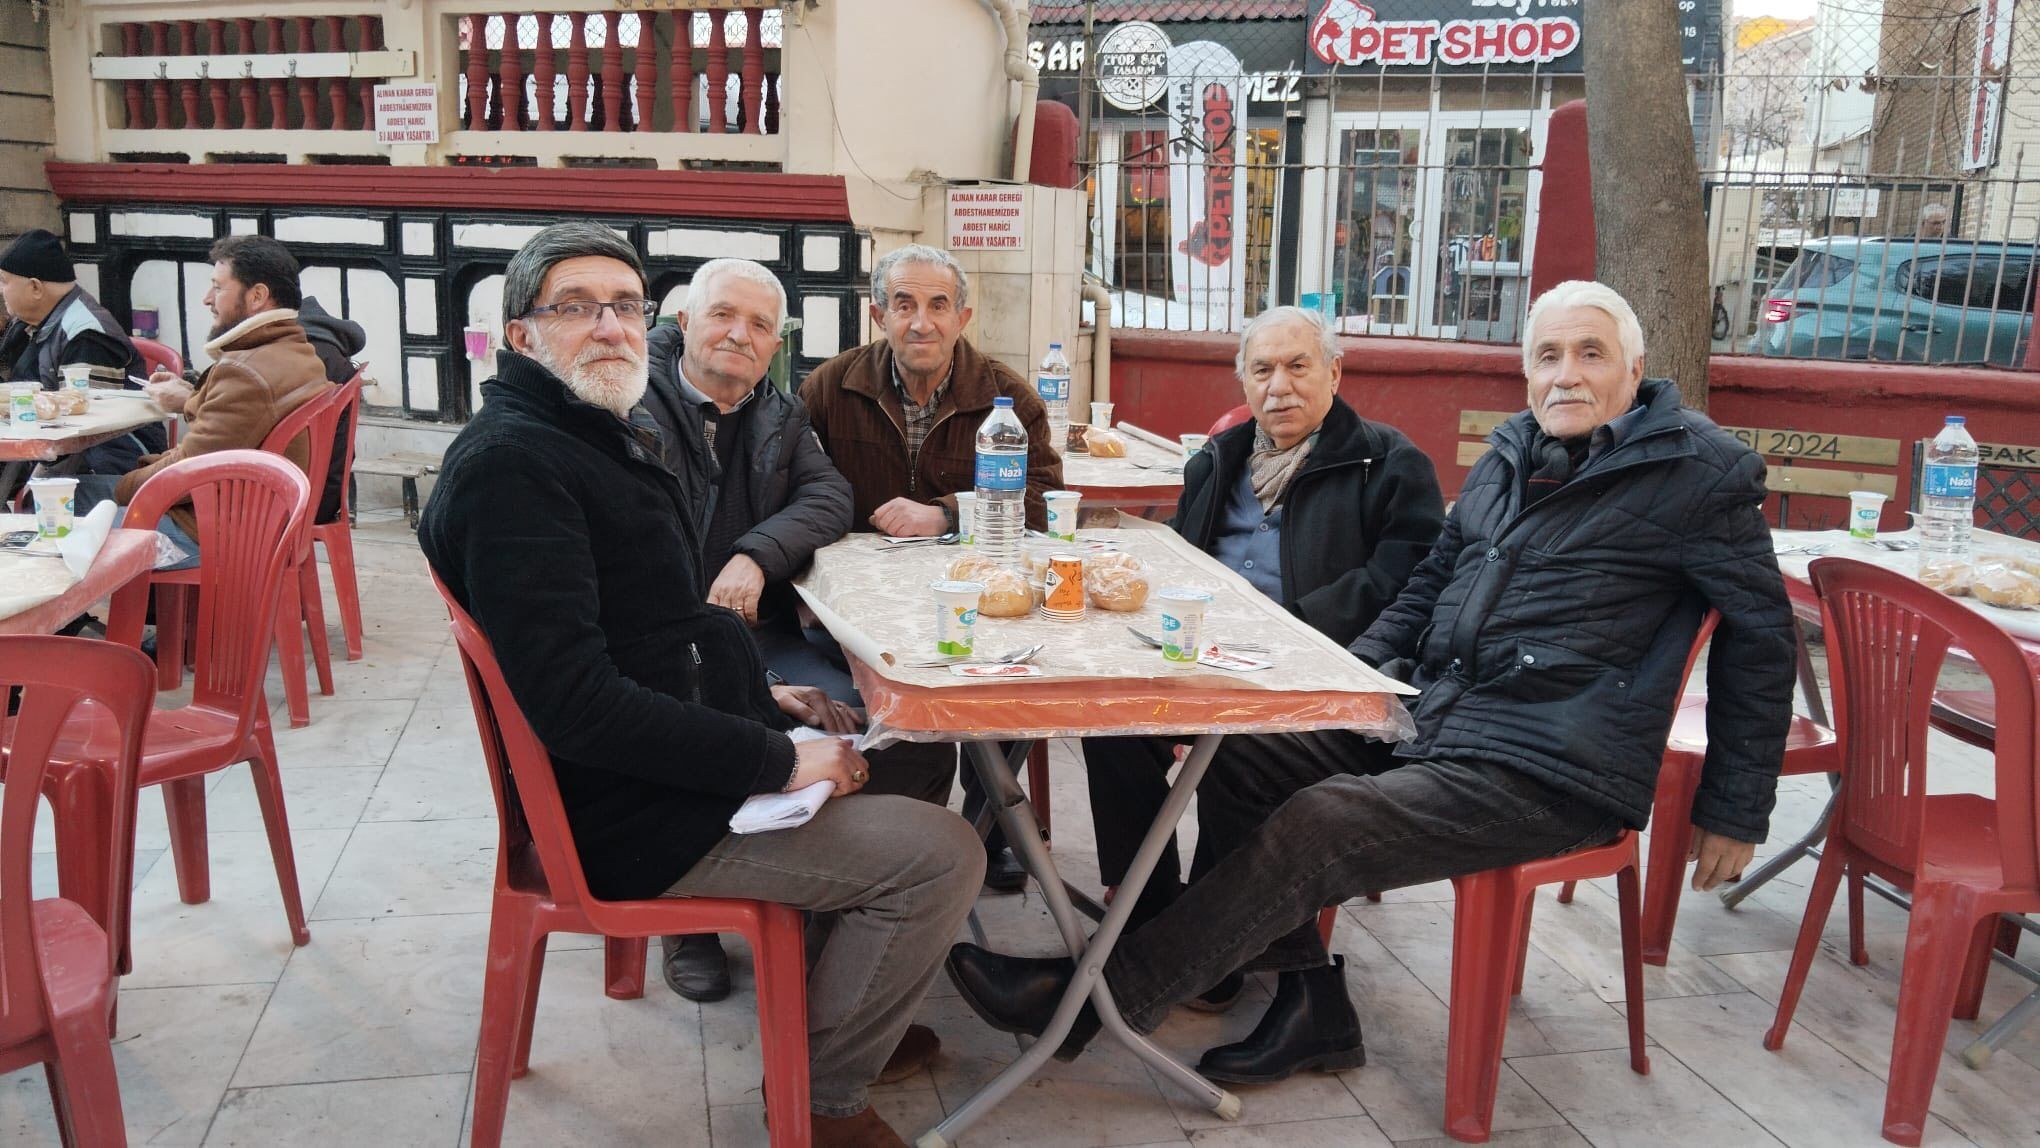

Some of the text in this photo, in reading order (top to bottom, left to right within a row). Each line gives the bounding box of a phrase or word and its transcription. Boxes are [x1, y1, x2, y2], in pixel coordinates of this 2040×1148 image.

[1350, 22, 1575, 60] PET SHOP
[951, 193, 974, 202] ALINAN
[975, 193, 998, 202] KARAR
[962, 223, 987, 232] ABDEST
[952, 236, 961, 247] SU
[962, 236, 985, 247] ALMAK
[985, 236, 1017, 247] YASAKTIR
[1768, 432, 1842, 459] 2024
[1977, 444, 2037, 464] ŞAK
